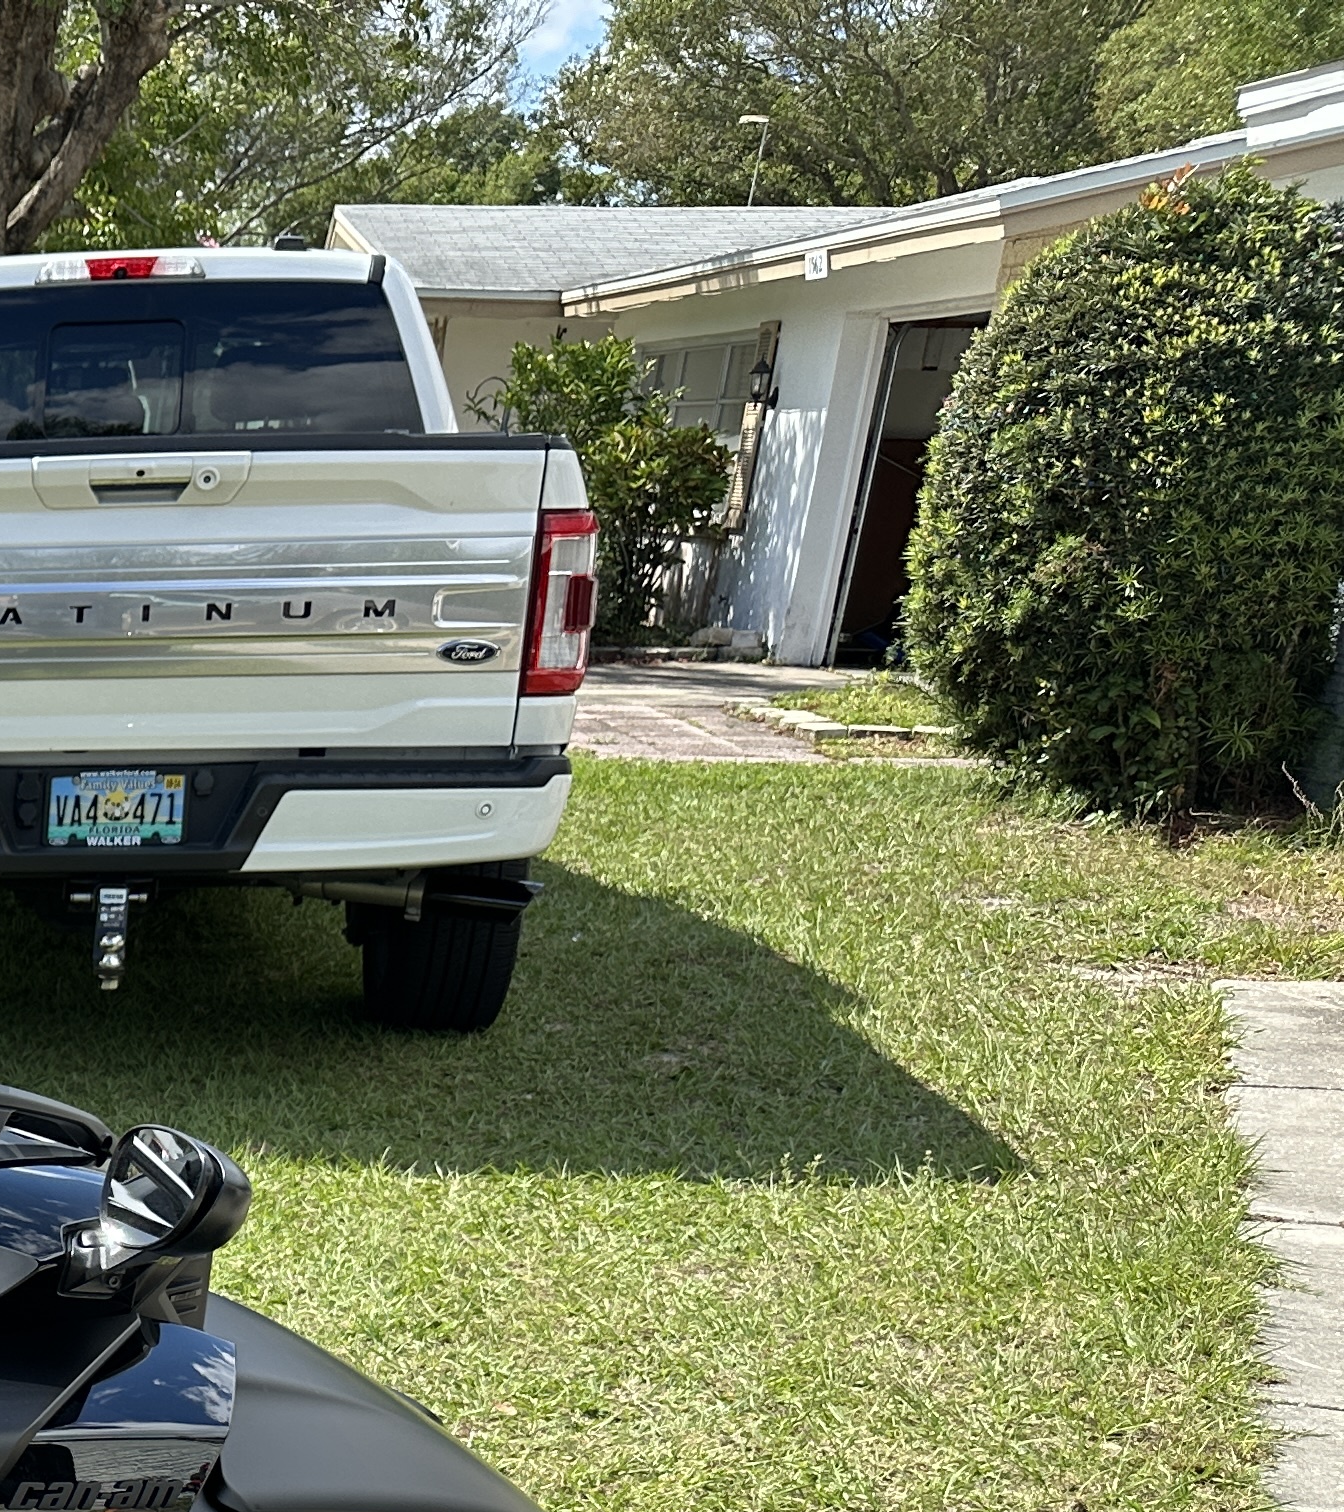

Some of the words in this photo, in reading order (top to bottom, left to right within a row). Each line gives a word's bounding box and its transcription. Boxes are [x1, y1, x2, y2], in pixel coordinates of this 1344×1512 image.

[80, 779, 119, 792] Family
[119, 778, 156, 790] Values
[56, 793, 98, 826] VA4
[133, 792, 176, 825] 471
[88, 825, 140, 835] FLORIDA
[86, 835, 141, 847] WALKER
[7, 1480, 184, 1511] can-am
